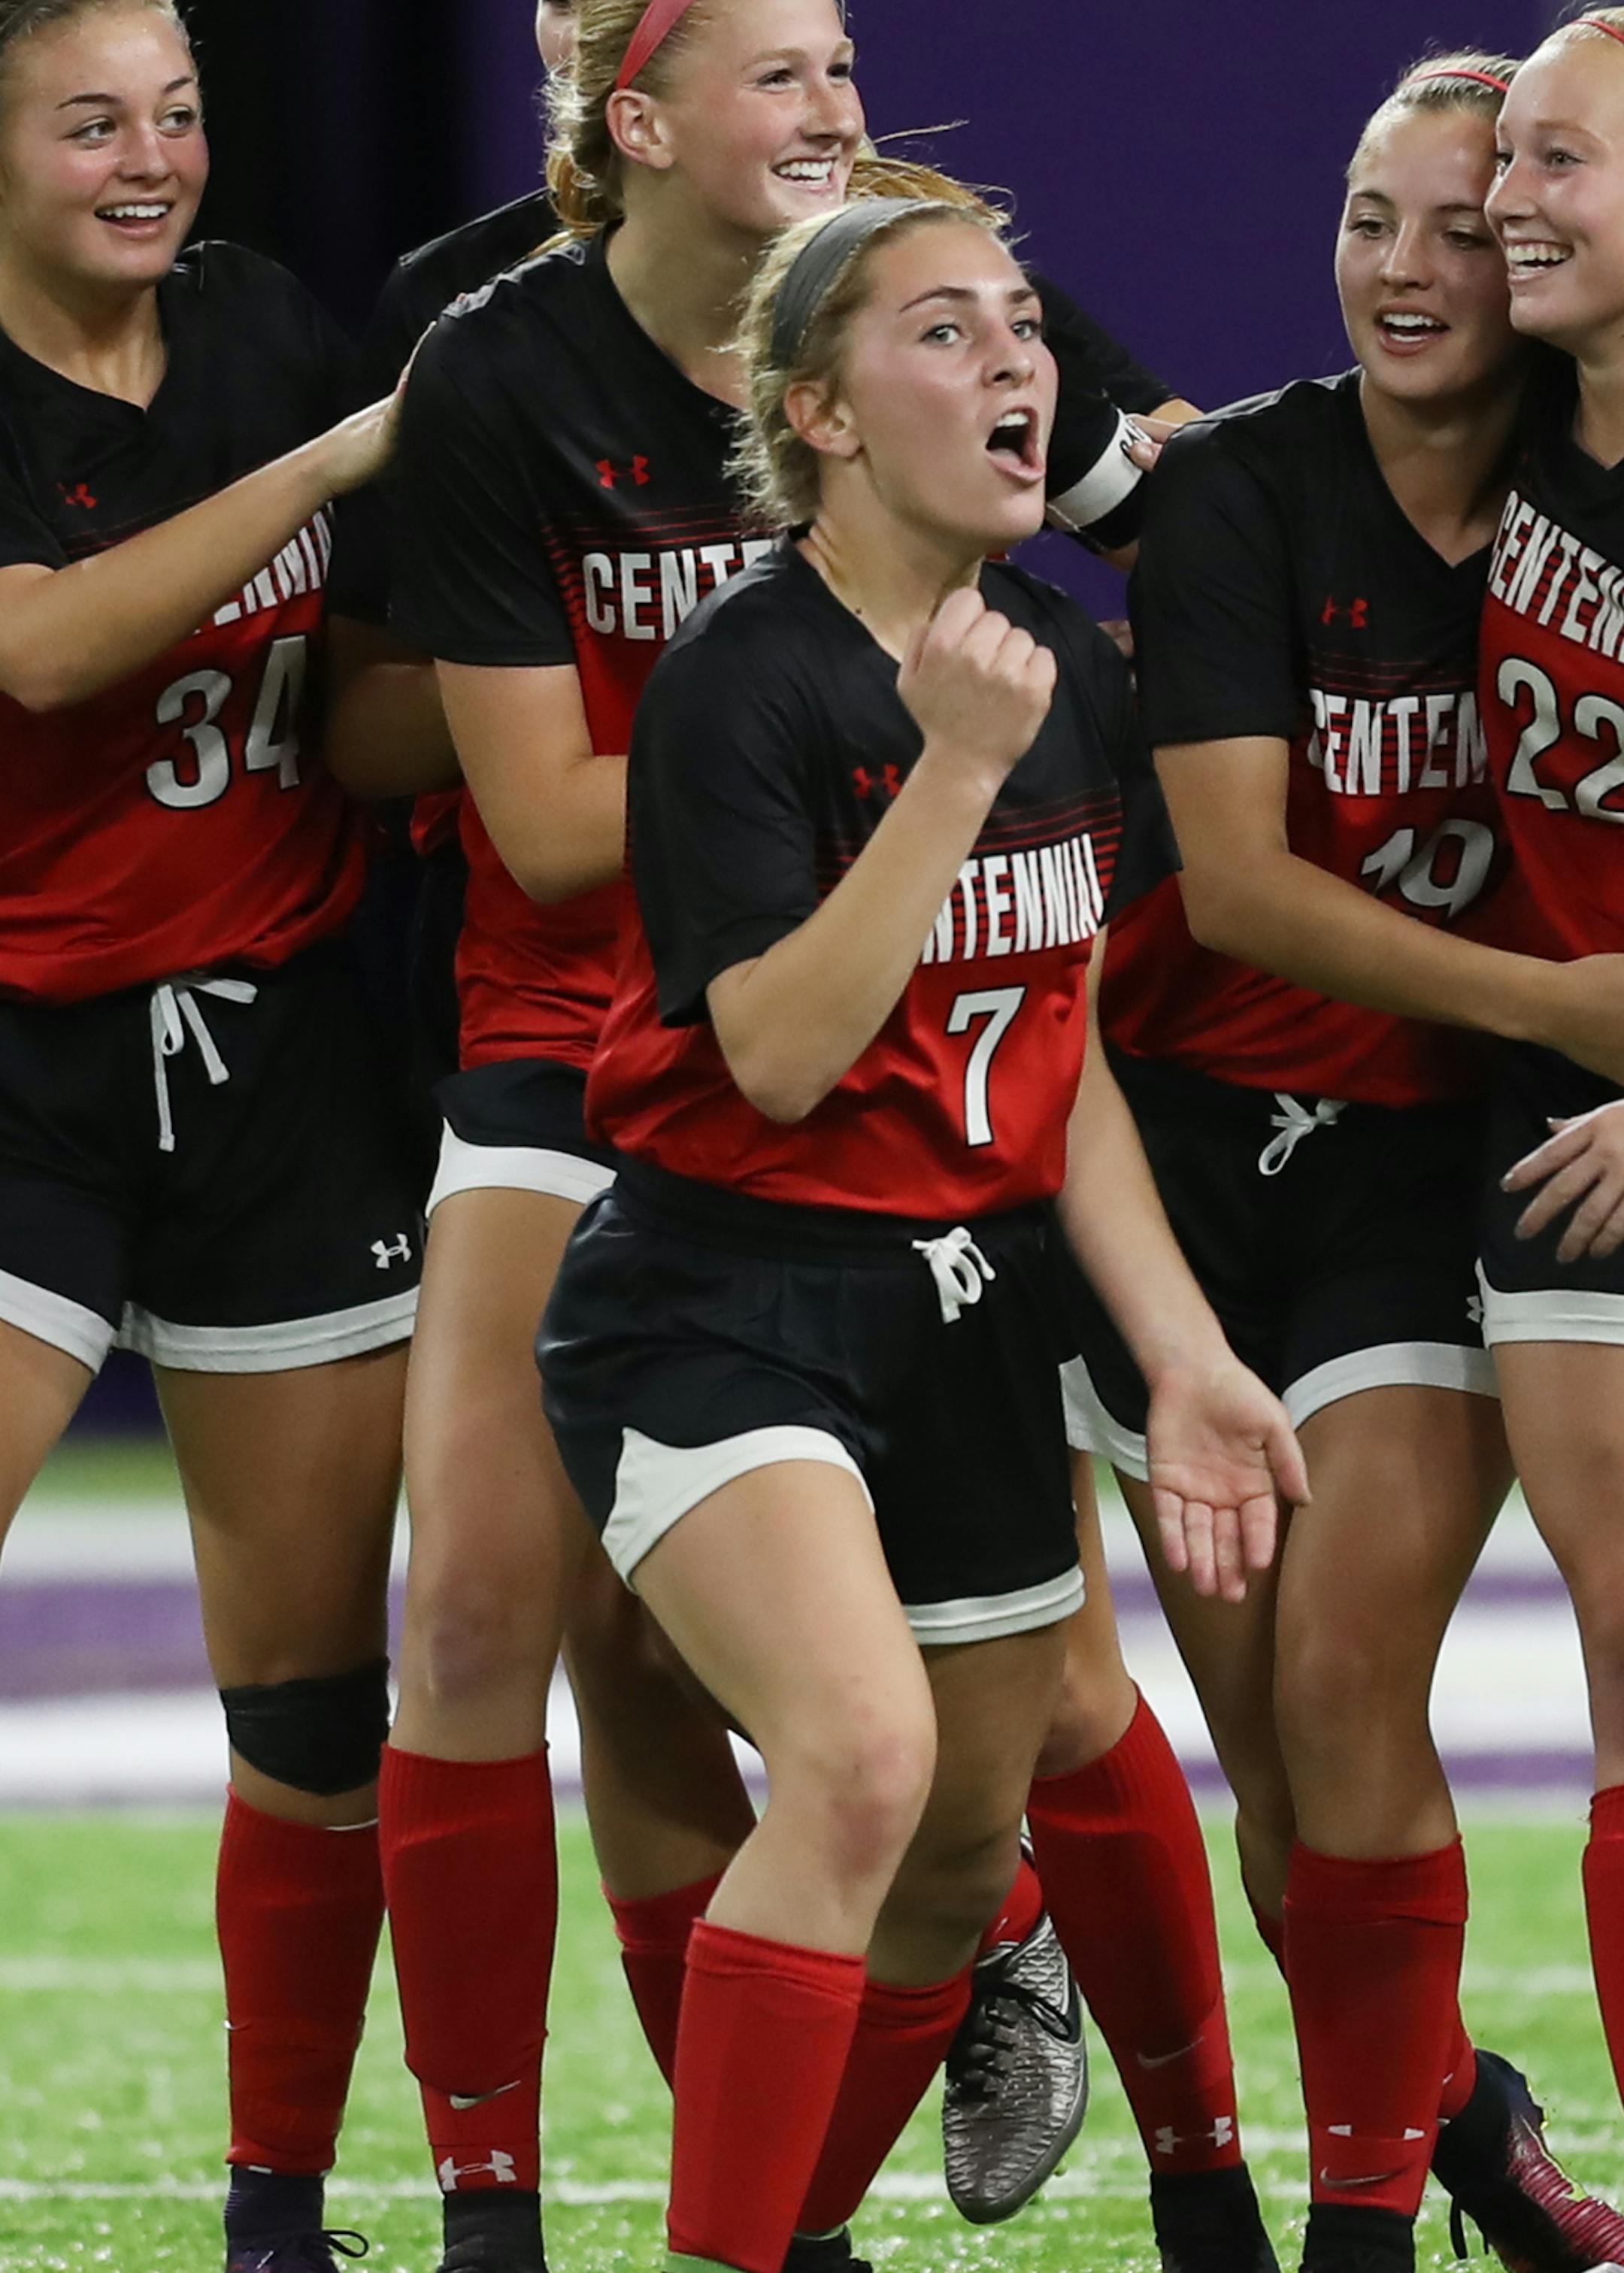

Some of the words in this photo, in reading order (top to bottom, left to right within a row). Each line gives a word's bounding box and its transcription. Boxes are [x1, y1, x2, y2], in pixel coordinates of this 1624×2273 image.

[582, 539, 774, 641] CENT
[1488, 490, 1624, 664] CENTEN
[147, 634, 306, 808] 34
[1498, 658, 1624, 824] 22
[947, 986, 1026, 1147] 7
